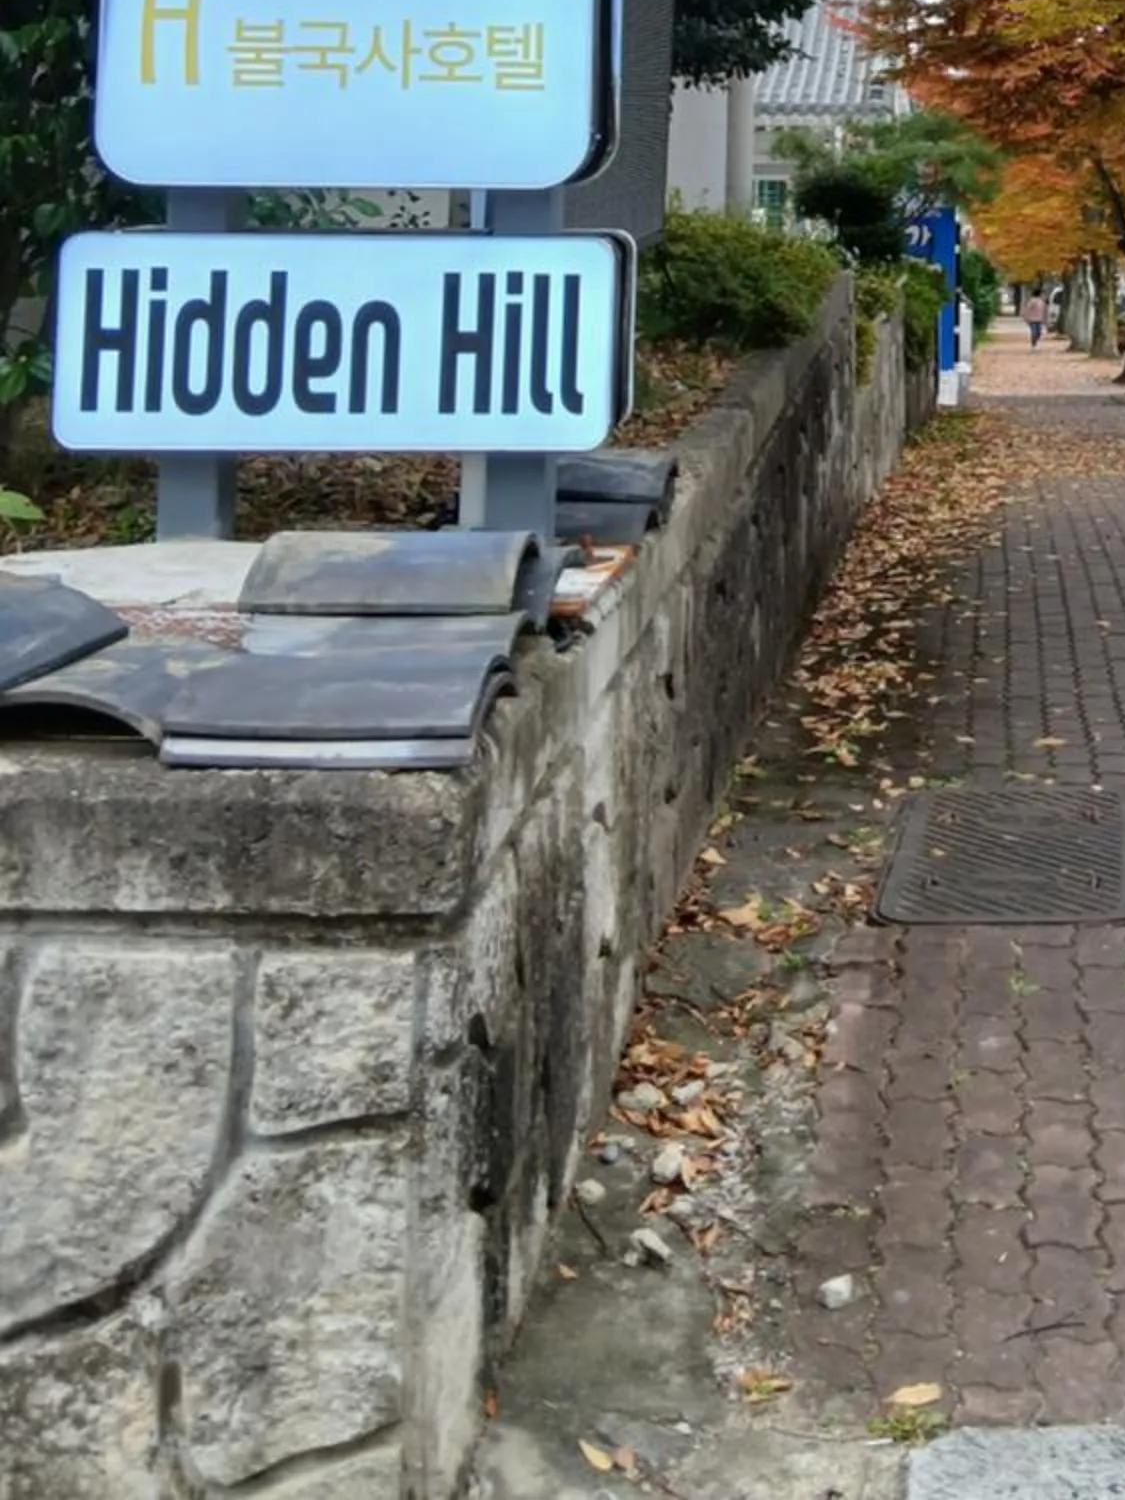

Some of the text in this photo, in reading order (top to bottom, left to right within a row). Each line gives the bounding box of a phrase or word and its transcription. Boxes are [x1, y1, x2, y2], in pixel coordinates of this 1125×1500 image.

[226, 17, 545, 92] 불국사호텔
[80, 267, 584, 416] Hidden Hill
